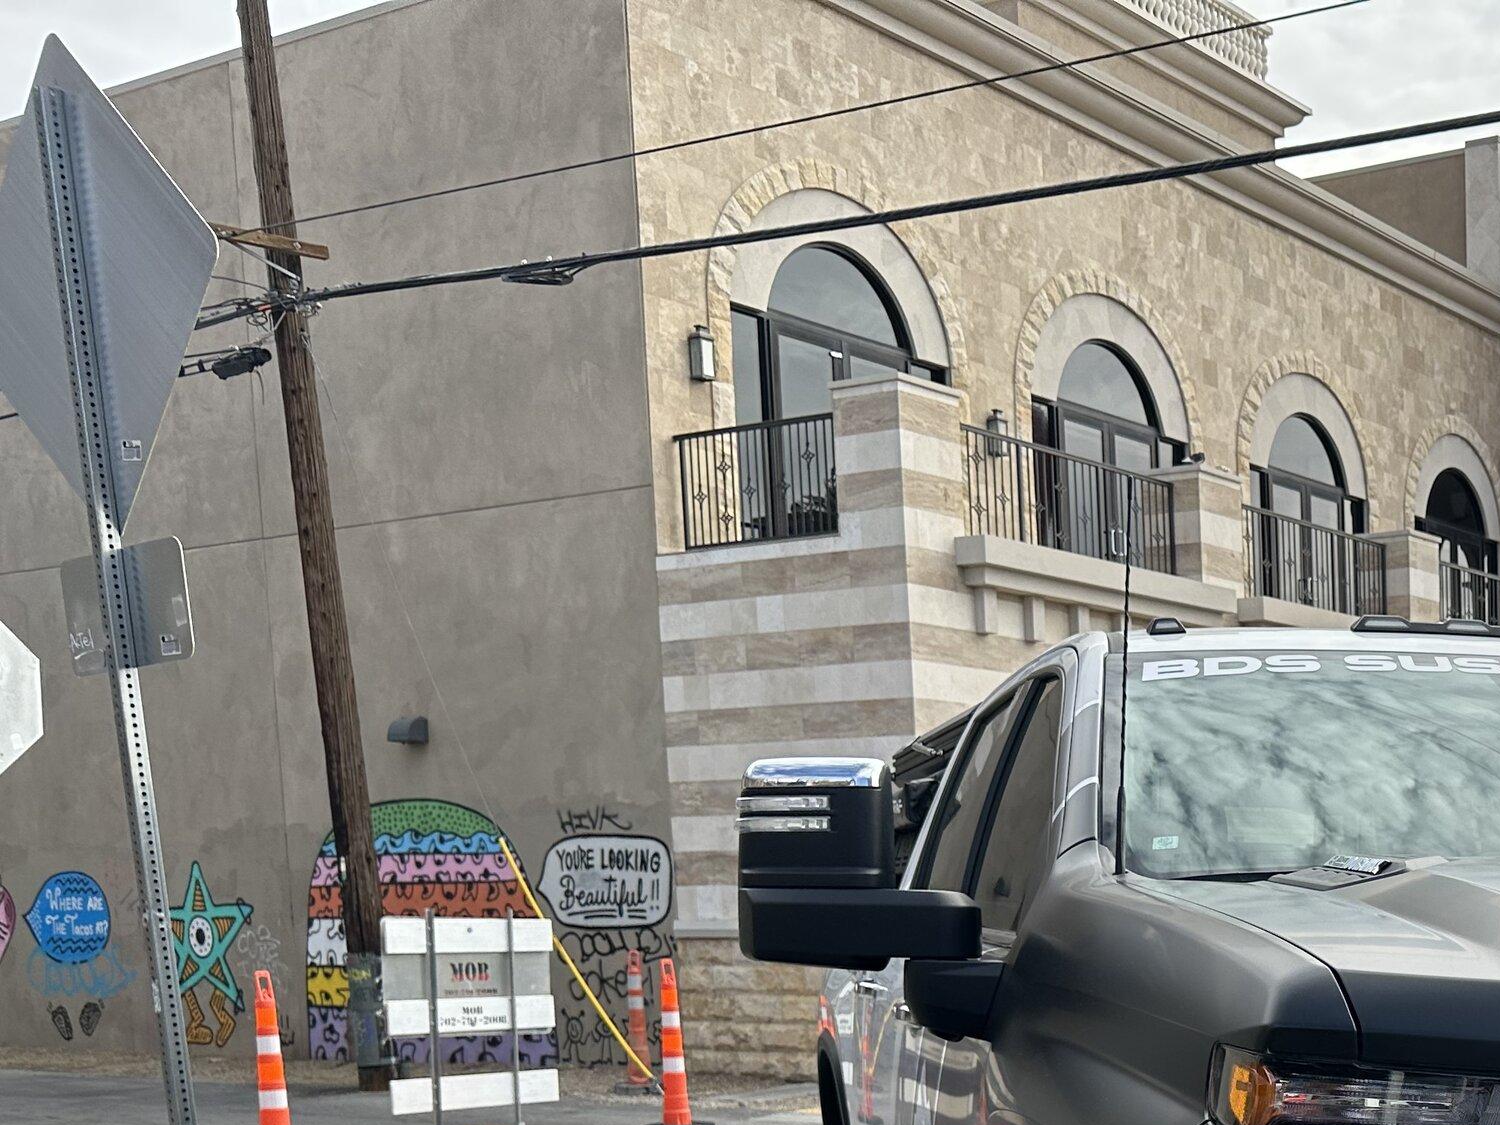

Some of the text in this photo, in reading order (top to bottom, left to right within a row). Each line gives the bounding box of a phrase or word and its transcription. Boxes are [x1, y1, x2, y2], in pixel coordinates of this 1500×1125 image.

[1142, 654, 1322, 682] BDS
[600, 848, 661, 873] LOOKING
[45, 887, 104, 911] WHERE ARE
[45, 914, 67, 935] THE
[450, 961, 490, 982] MOB
[462, 1005, 483, 1015] MOB
